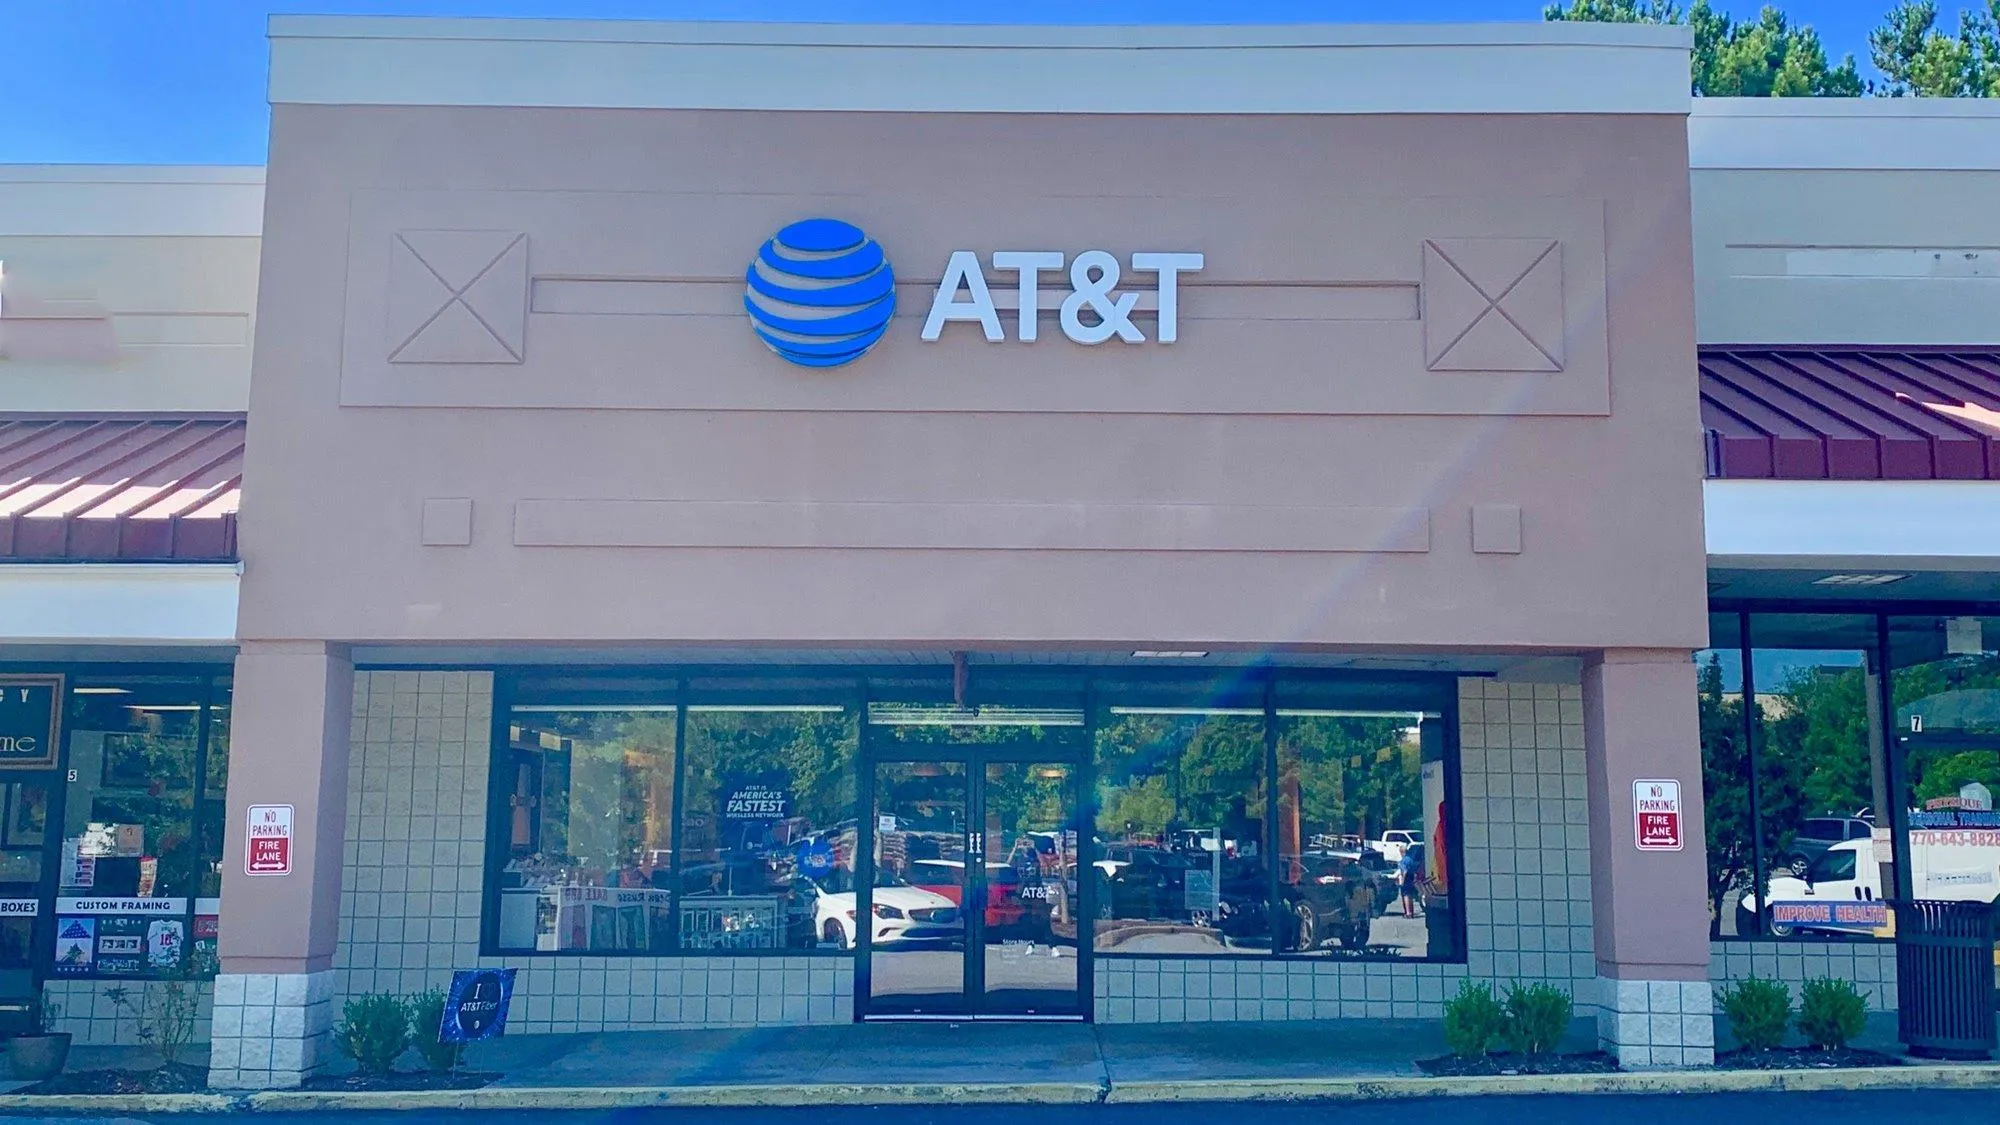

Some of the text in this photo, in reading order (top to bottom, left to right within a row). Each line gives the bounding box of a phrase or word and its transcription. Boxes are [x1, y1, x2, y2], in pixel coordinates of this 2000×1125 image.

[921, 250, 1204, 345] AT&T
[1912, 716, 1920, 731] 7
[69, 770, 76, 781] 5
[731, 791, 782, 800] AMERICA'S
[1650, 786, 1663, 798] NO
[727, 800, 786, 812] FASTEST
[1640, 800, 1675, 811] PARKING
[264, 811, 277, 823] NO
[1647, 815, 1669, 825] FIRE
[252, 825, 288, 836] PARKING
[1646, 826, 1672, 836] LANE
[1910, 832, 2000, 847] 770-643-8828
[258, 841, 280, 850] FIRE
[256, 852, 281, 861] LANE
[1, 902, 36, 913] BOXES
[76, 901, 171, 910] CUSTOM FRAMING
[1773, 904, 1887, 923] IMPROVE HEALTH
[461, 1001, 481, 1012] AT&T
